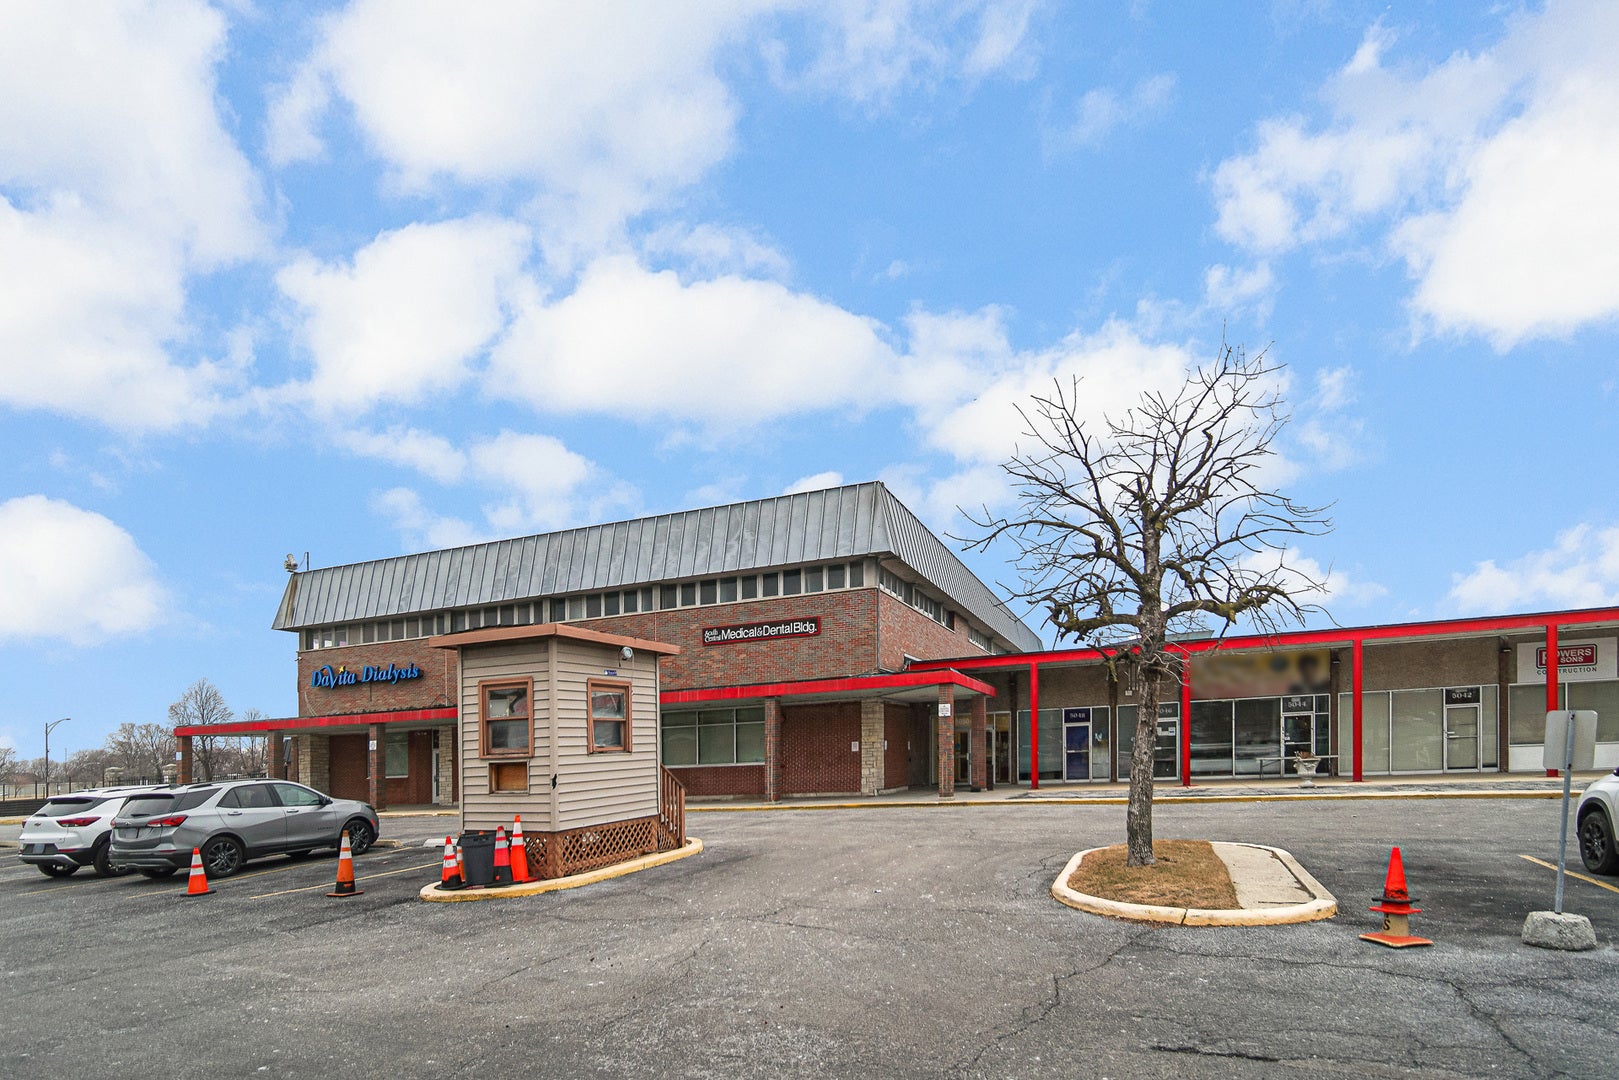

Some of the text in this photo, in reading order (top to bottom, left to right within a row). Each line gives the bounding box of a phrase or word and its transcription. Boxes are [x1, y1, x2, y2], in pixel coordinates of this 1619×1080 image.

[311, 662, 421, 689] DaVita Dialysis
[1537, 666, 1597, 675] COTRUCTION
